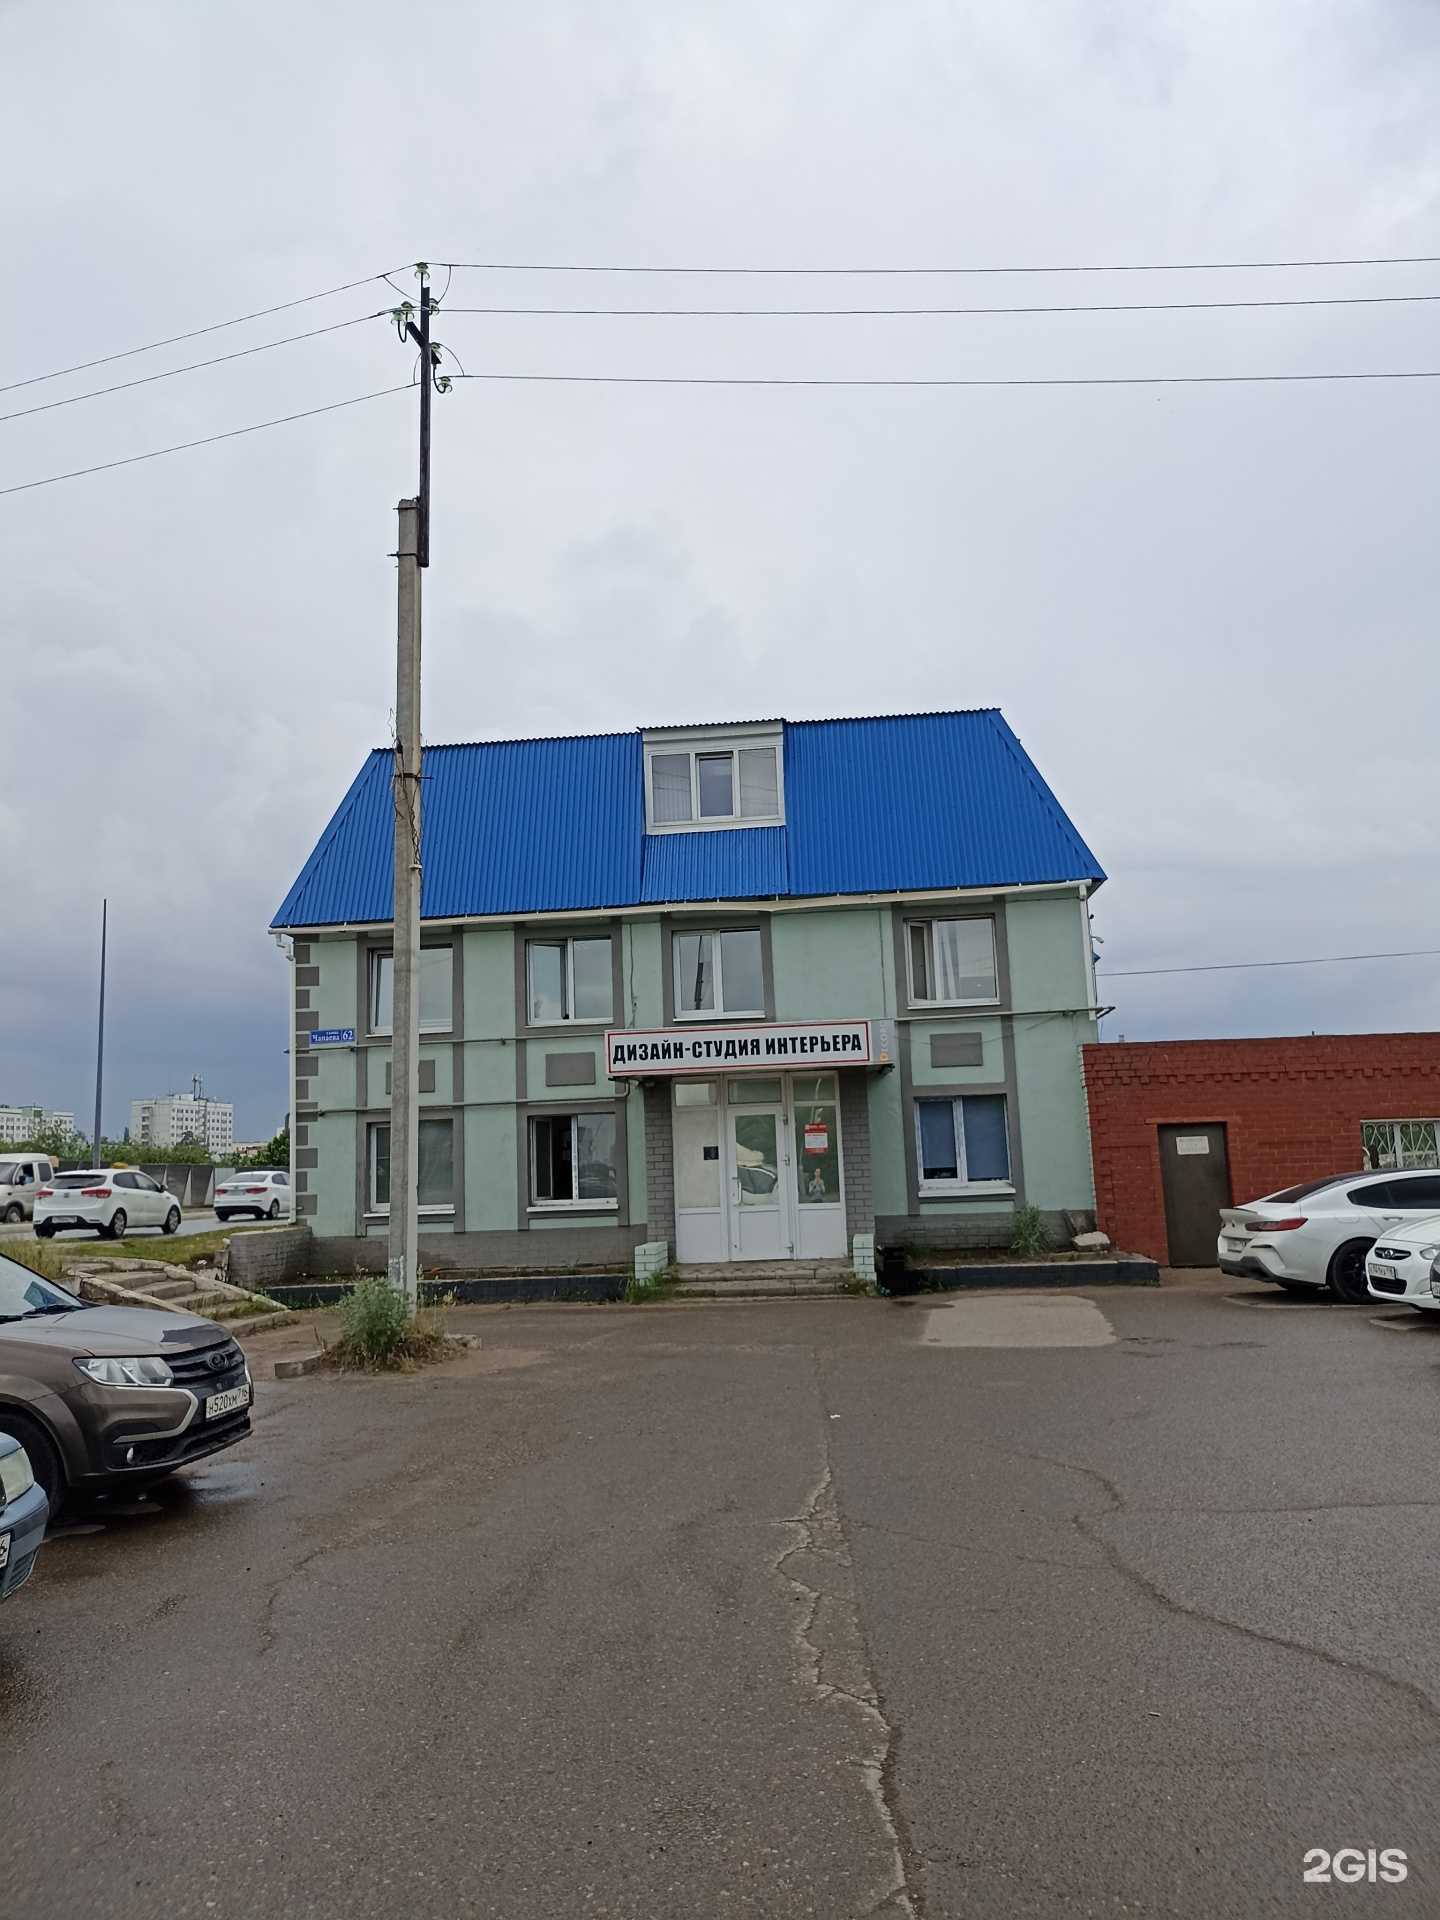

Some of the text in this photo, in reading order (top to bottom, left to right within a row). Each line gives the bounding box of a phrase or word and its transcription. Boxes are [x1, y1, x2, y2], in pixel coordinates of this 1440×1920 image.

[342, 1030, 353, 1040] 62
[612, 1033, 862, 1064] ДИЗАЙН-СТУДИЯ ИНТЕРЬЕРА
